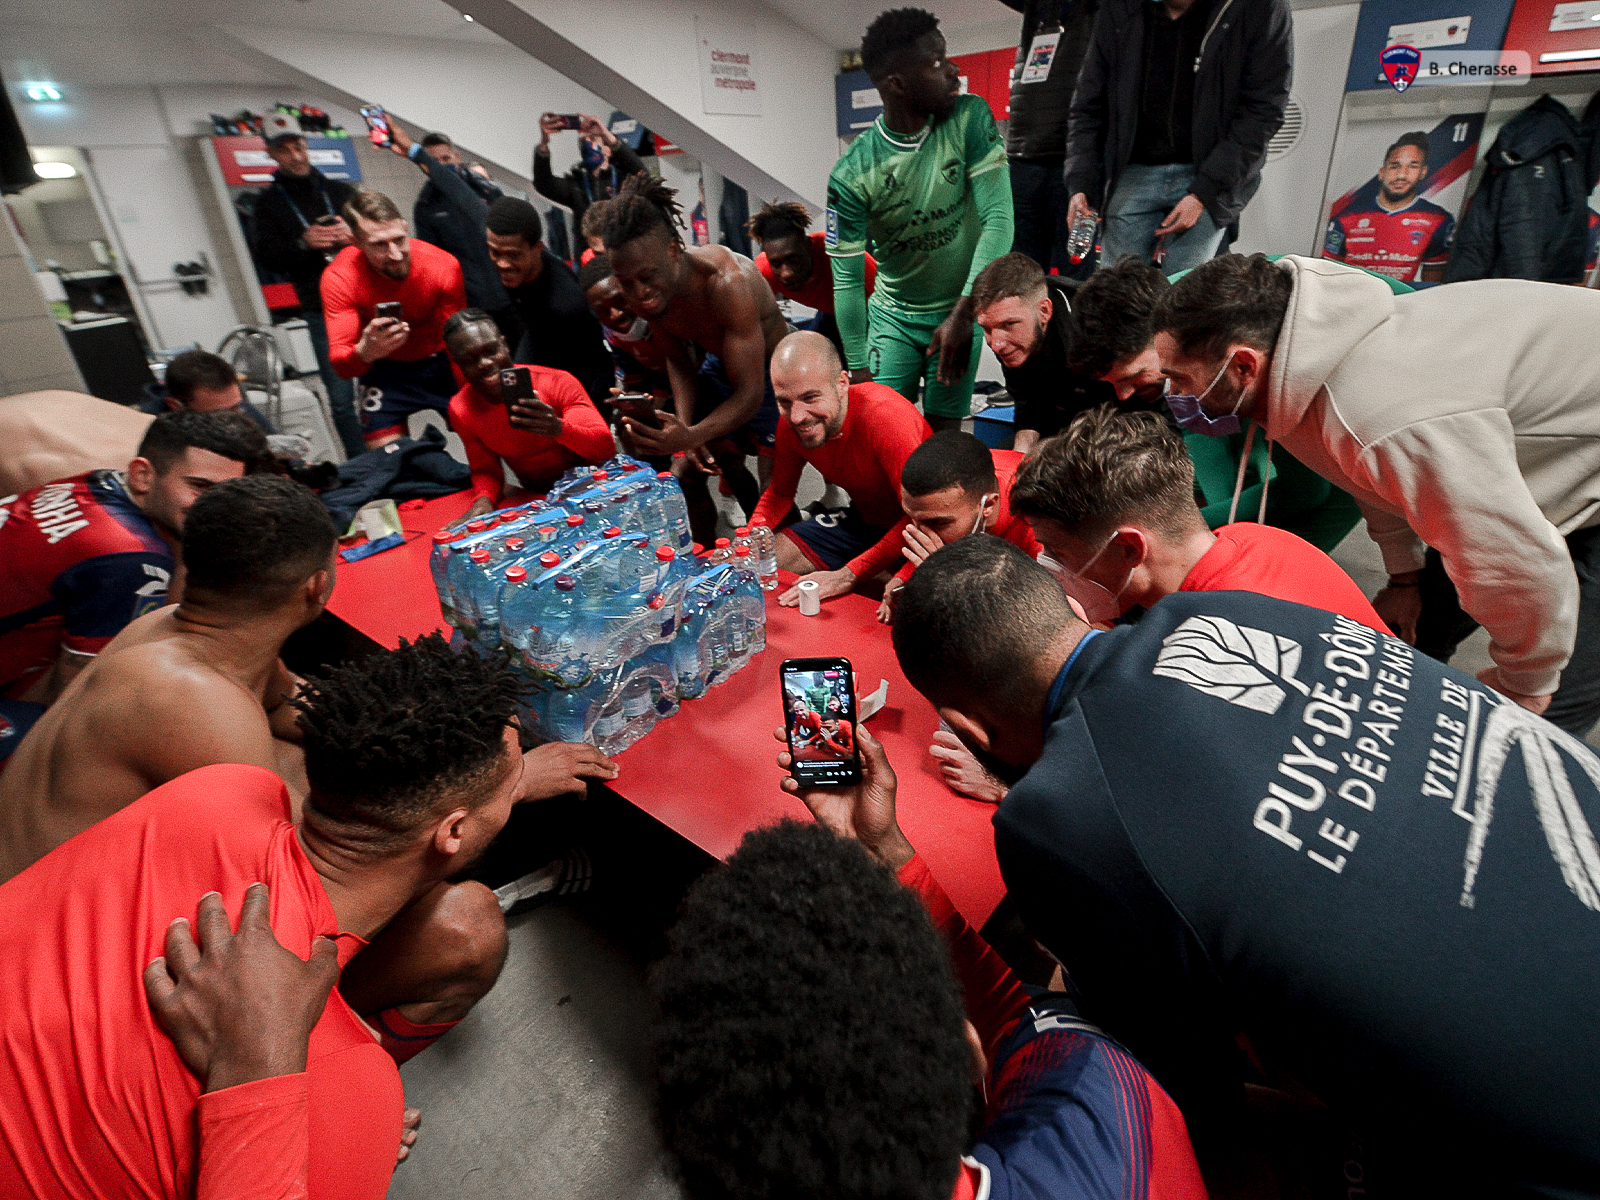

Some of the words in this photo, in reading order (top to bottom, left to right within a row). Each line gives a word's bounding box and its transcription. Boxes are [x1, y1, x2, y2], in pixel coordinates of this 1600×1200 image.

[1440, 677, 1470, 712] DE
[1420, 712, 1467, 799] VILLE
[1307, 817, 1360, 874] LE
